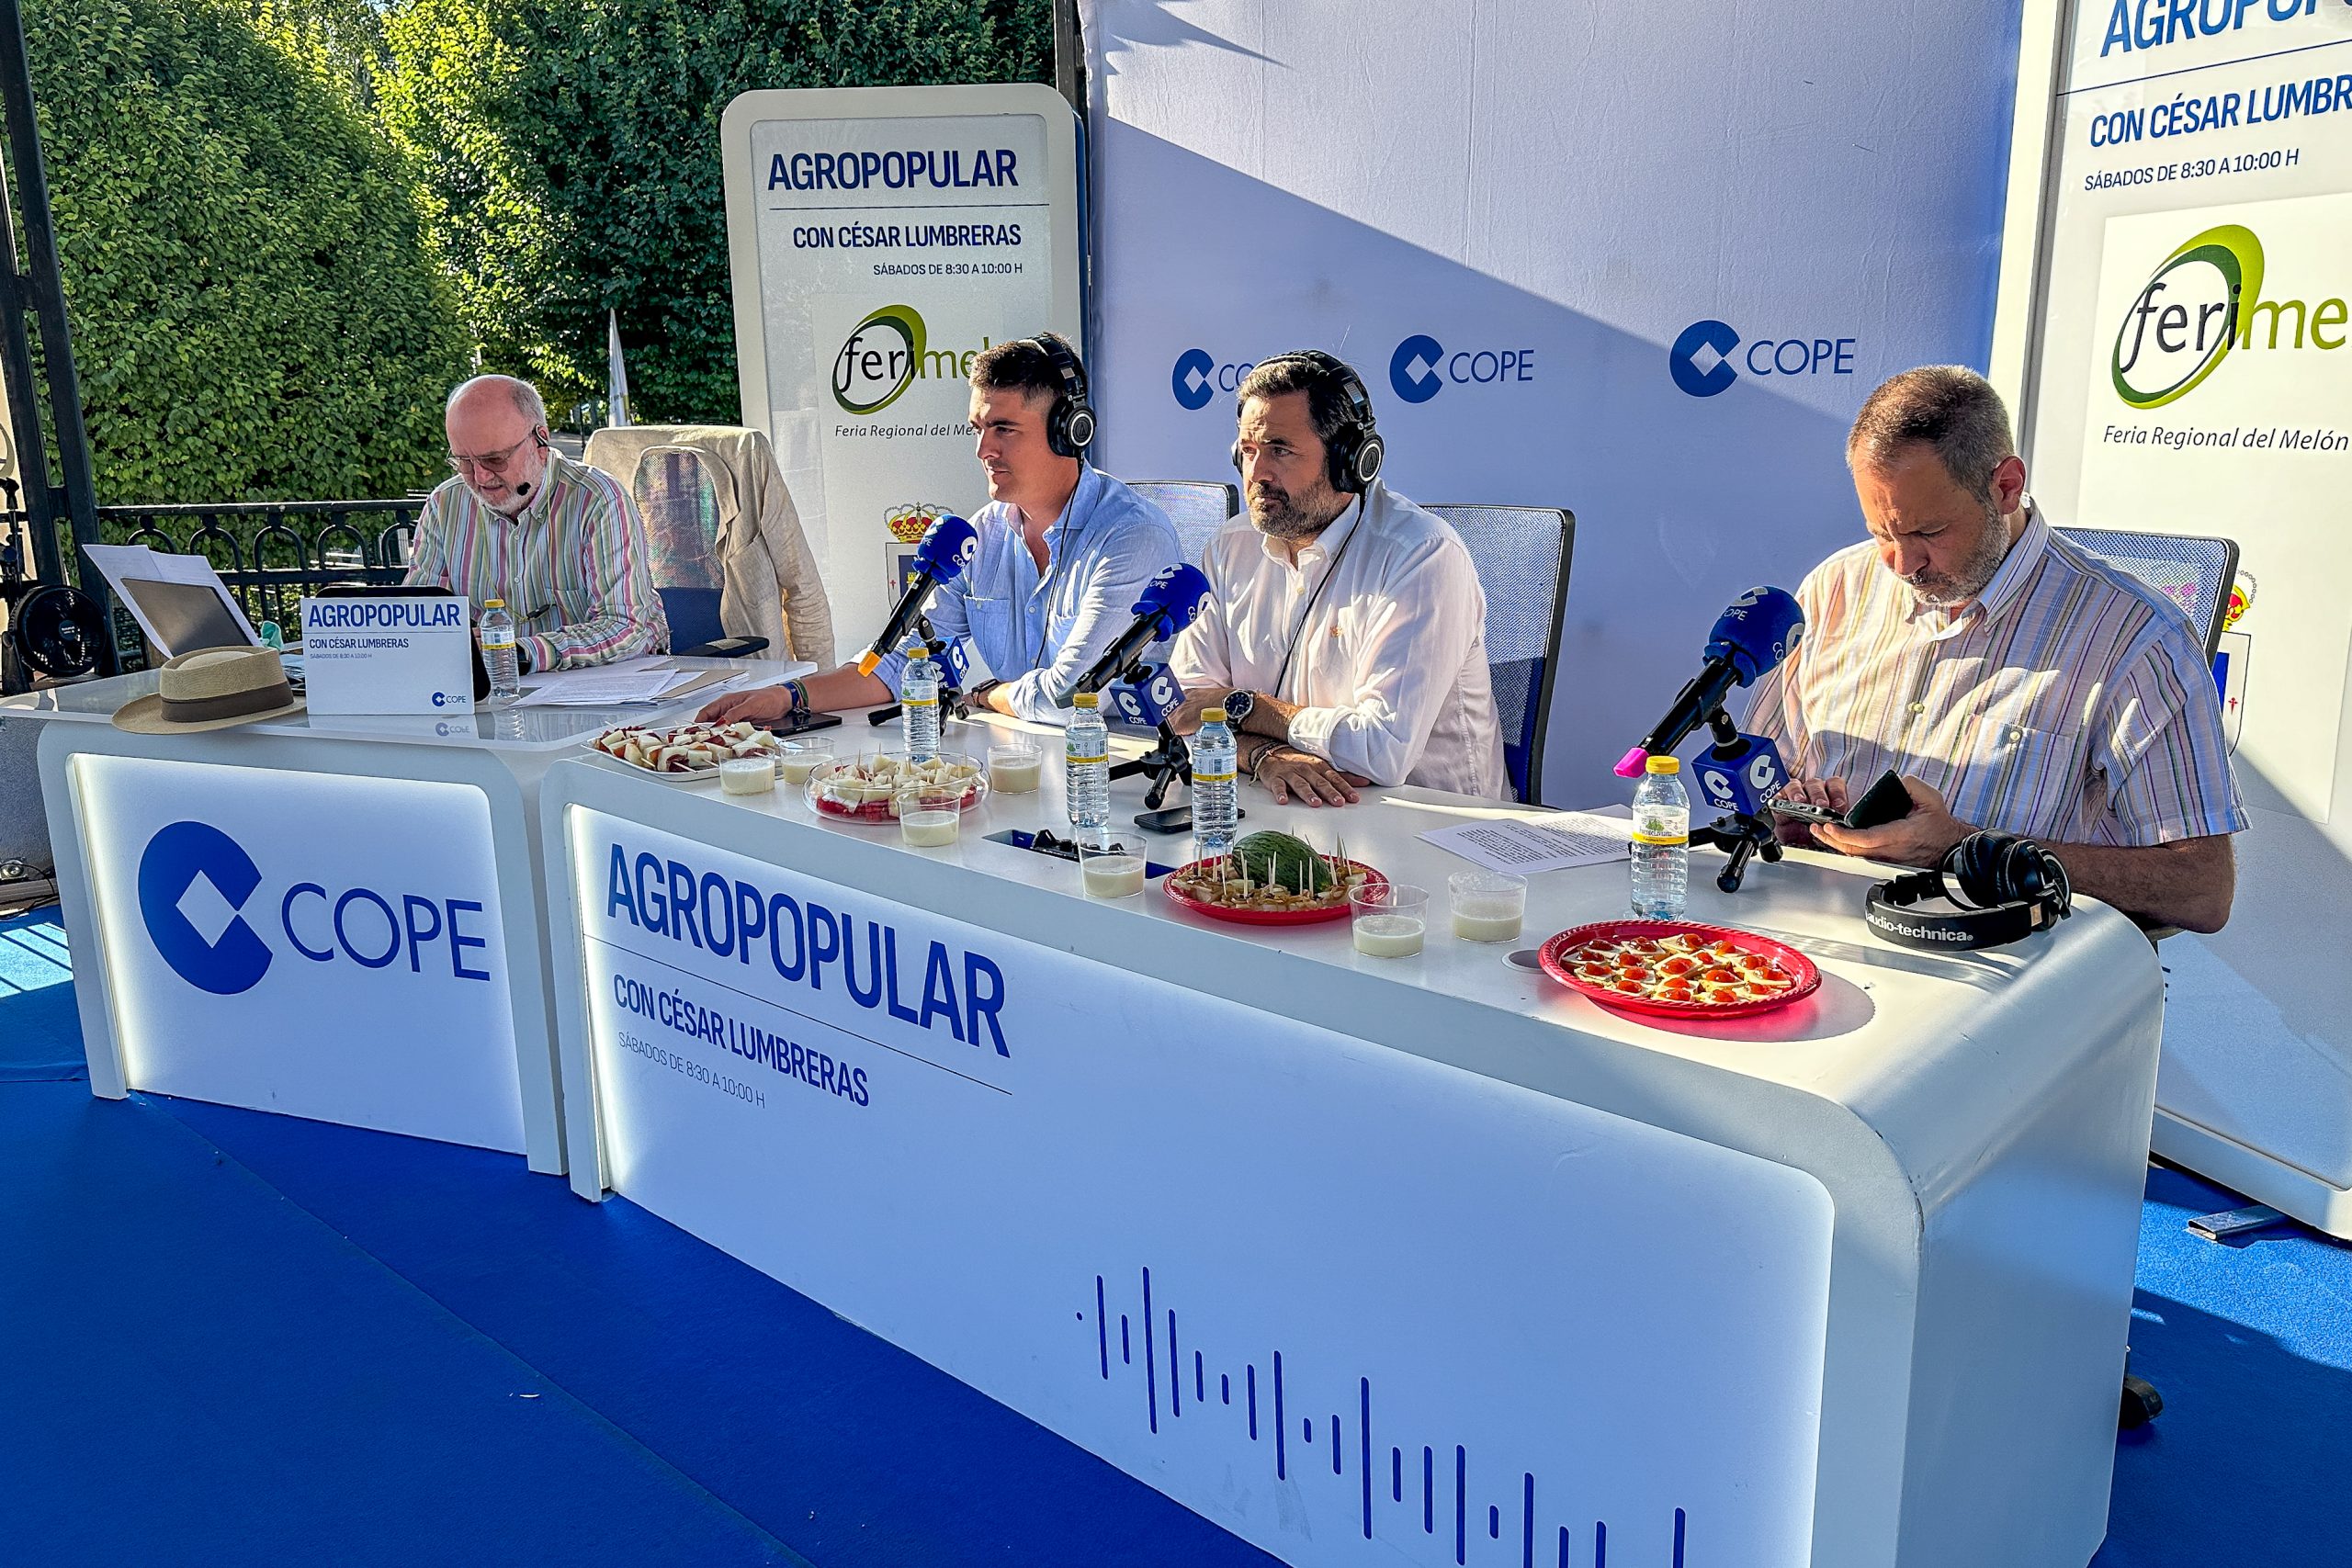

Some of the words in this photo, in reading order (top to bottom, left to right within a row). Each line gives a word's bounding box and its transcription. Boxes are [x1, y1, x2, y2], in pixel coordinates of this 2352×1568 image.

[2090, 107, 2144, 148] CON
[2149, 93, 2241, 139] CÉSAR
[768, 149, 1019, 191] AGROPOPULAR
[2085, 167, 2154, 191] SÁBADOS
[2157, 164, 2177, 182] DE
[2180, 159, 2215, 178] 8:30
[2218, 157, 2231, 175] A
[2233, 151, 2281, 173] 10:00
[2285, 148, 2300, 166] H
[793, 226, 834, 249] CON
[838, 220, 901, 248] CÉSAR
[905, 223, 1022, 247] LUMBRERAS
[873, 262, 926, 276] SÁBADOS
[928, 264, 943, 275] DE
[945, 264, 969, 275] 8:30
[971, 263, 979, 275] A
[981, 263, 1011, 274] 10:00
[1014, 263, 1023, 274] H
[2120, 282, 2352, 374] ferime
[1449, 349, 1534, 384] COPE
[1747, 338, 1856, 376] COPE
[1218, 363, 1255, 392] CO
[835, 424, 866, 437] Feria
[870, 423, 927, 439] Regional
[930, 423, 950, 437] del
[953, 423, 977, 436] Me
[2104, 425, 2147, 445] Feria
[2151, 426, 2239, 450] Regional
[2243, 427, 2276, 448] del
[2278, 429, 2349, 451] Melón
[1148, 580, 1169, 590] OPE
[308, 603, 461, 627] AGROPOPULAR
[1188, 606, 1196, 621] CO
[1724, 608, 1748, 622] OPE
[309, 638, 328, 649] CON
[329, 636, 356, 649] CÉSAR
[357, 637, 410, 649] LUMBRERAS
[1772, 641, 1784, 660] CO
[447, 695, 467, 704] COPE
[1161, 697, 1180, 716] COPE
[1128, 716, 1148, 725] COPE
[1759, 780, 1782, 804] COPE
[1713, 798, 1740, 812] COPE
[281, 882, 491, 982] COPE
[607, 842, 1012, 1059] AGROPOPULAR
[614, 974, 655, 1021] CON
[659, 988, 727, 1050] CÉSAR
[729, 1018, 869, 1107] LUMBRERAS
[618, 1031, 667, 1066] SÁBADOS
[669, 1053, 684, 1073] DE
[686, 1060, 710, 1085] 8:30
[712, 1071, 720, 1089] A
[721, 1075, 752, 1103] 10:00
[755, 1091, 766, 1110] H
